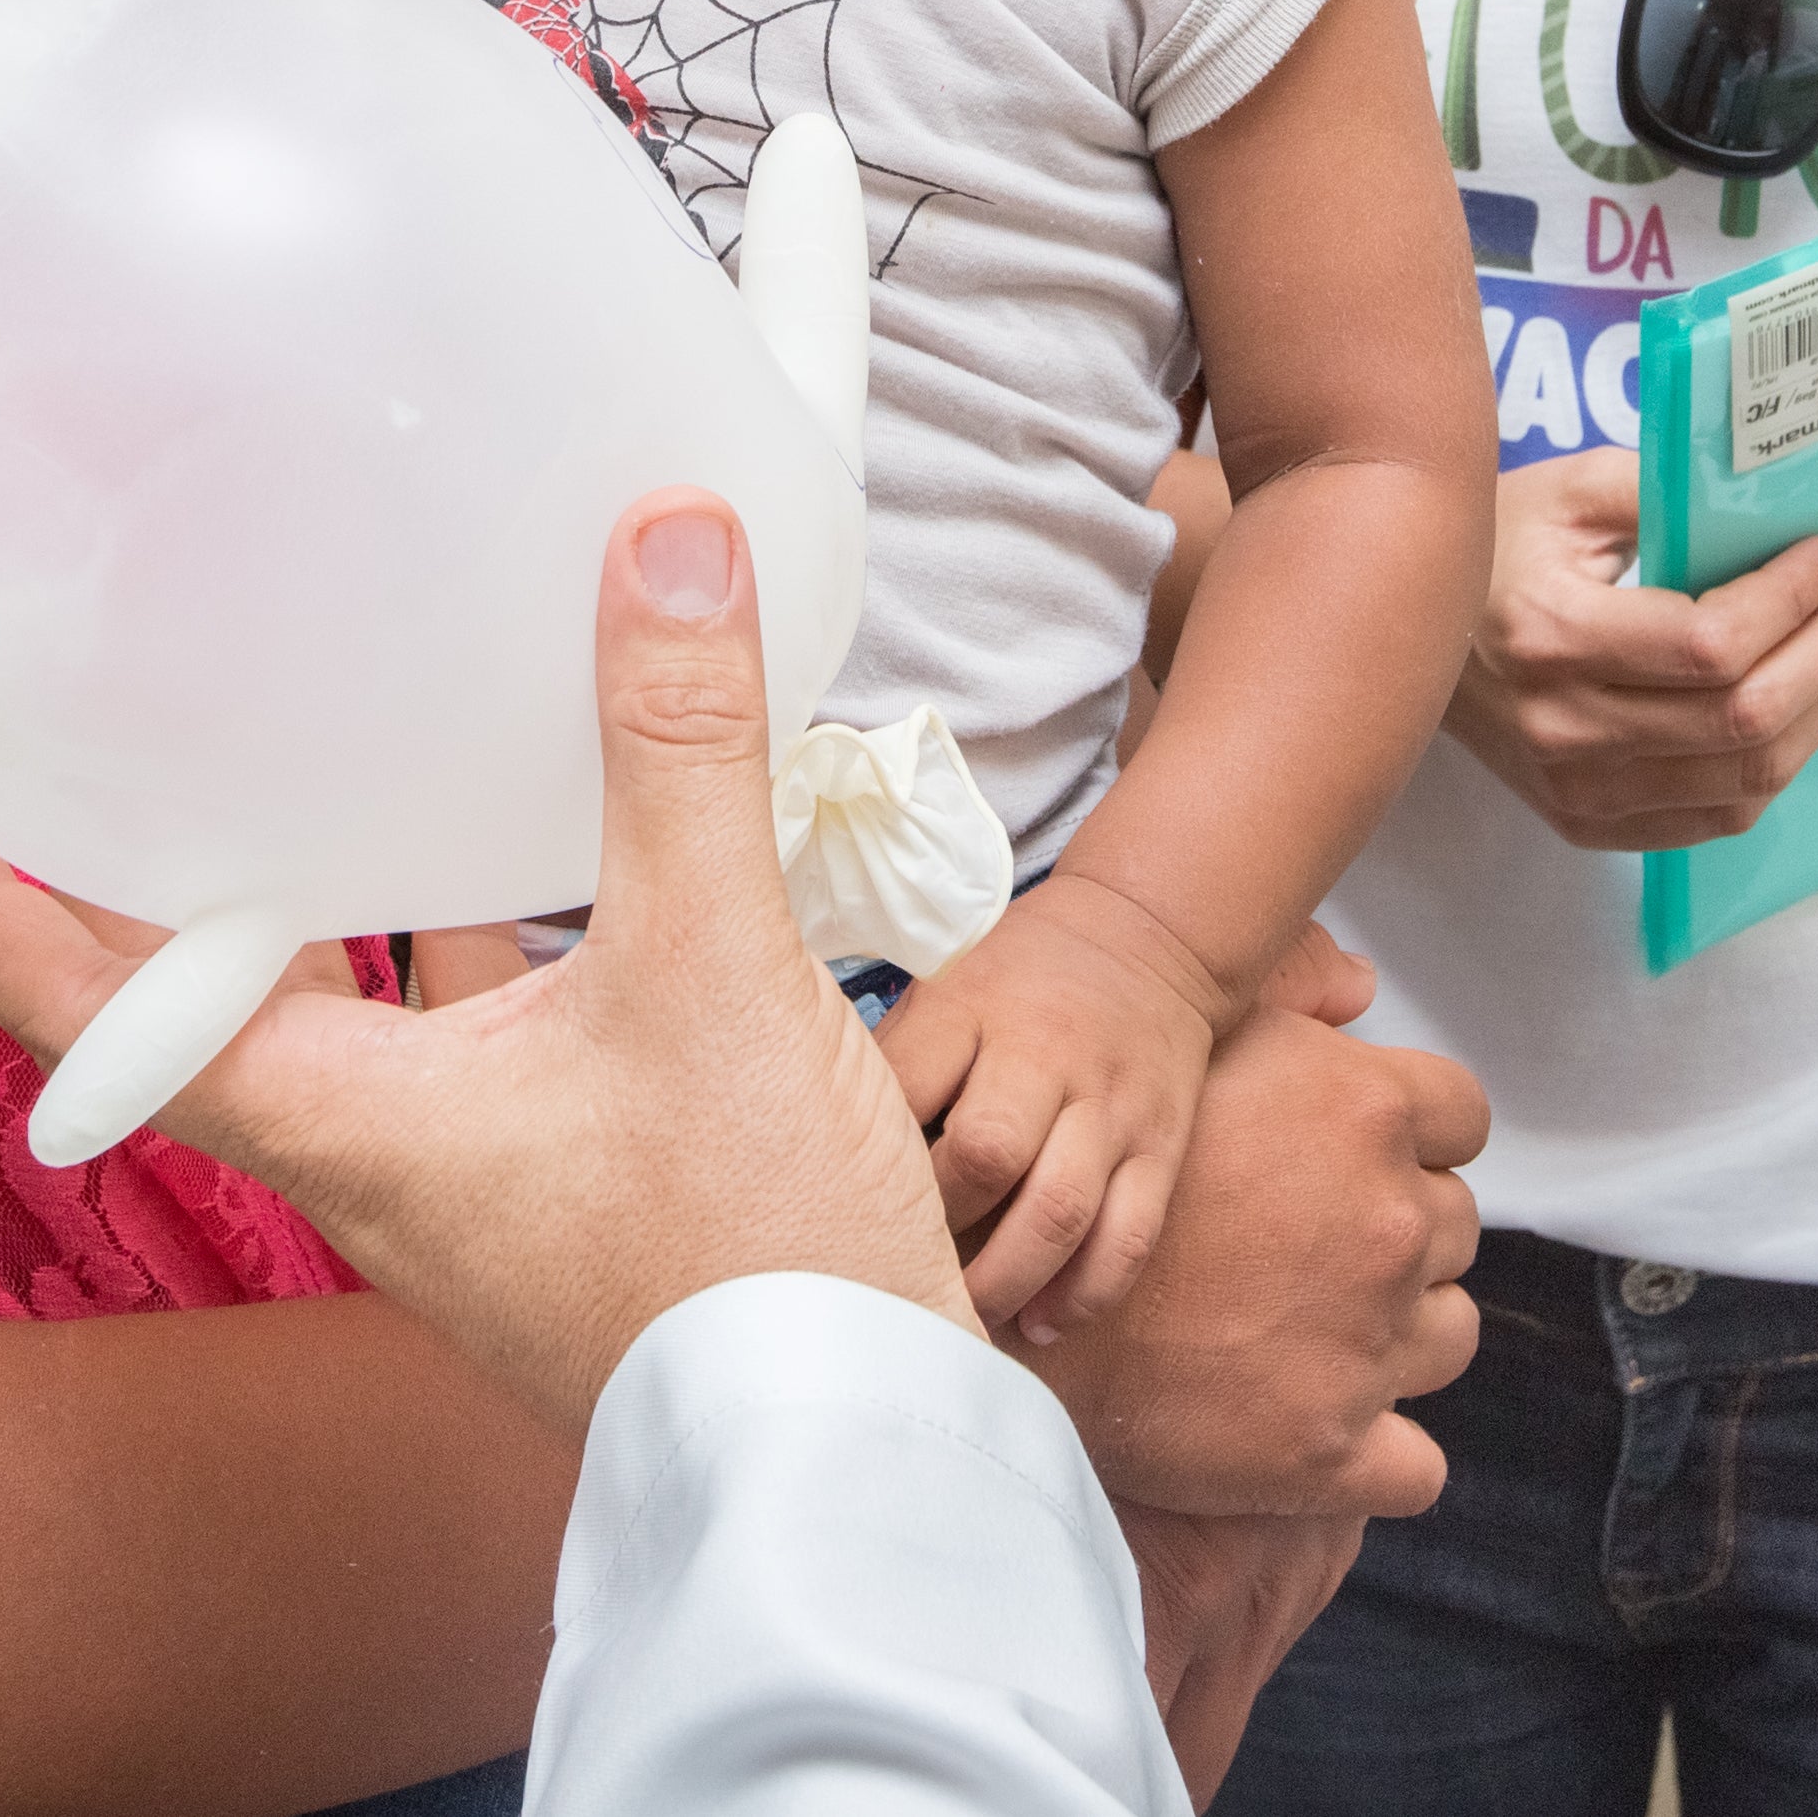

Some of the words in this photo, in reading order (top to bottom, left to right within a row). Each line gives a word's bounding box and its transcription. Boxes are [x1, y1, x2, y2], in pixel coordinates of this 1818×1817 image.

[1587, 196, 1674, 282] DA
[1746, 394, 1781, 423] F/C
[1794, 389, 1817, 404] Bag
